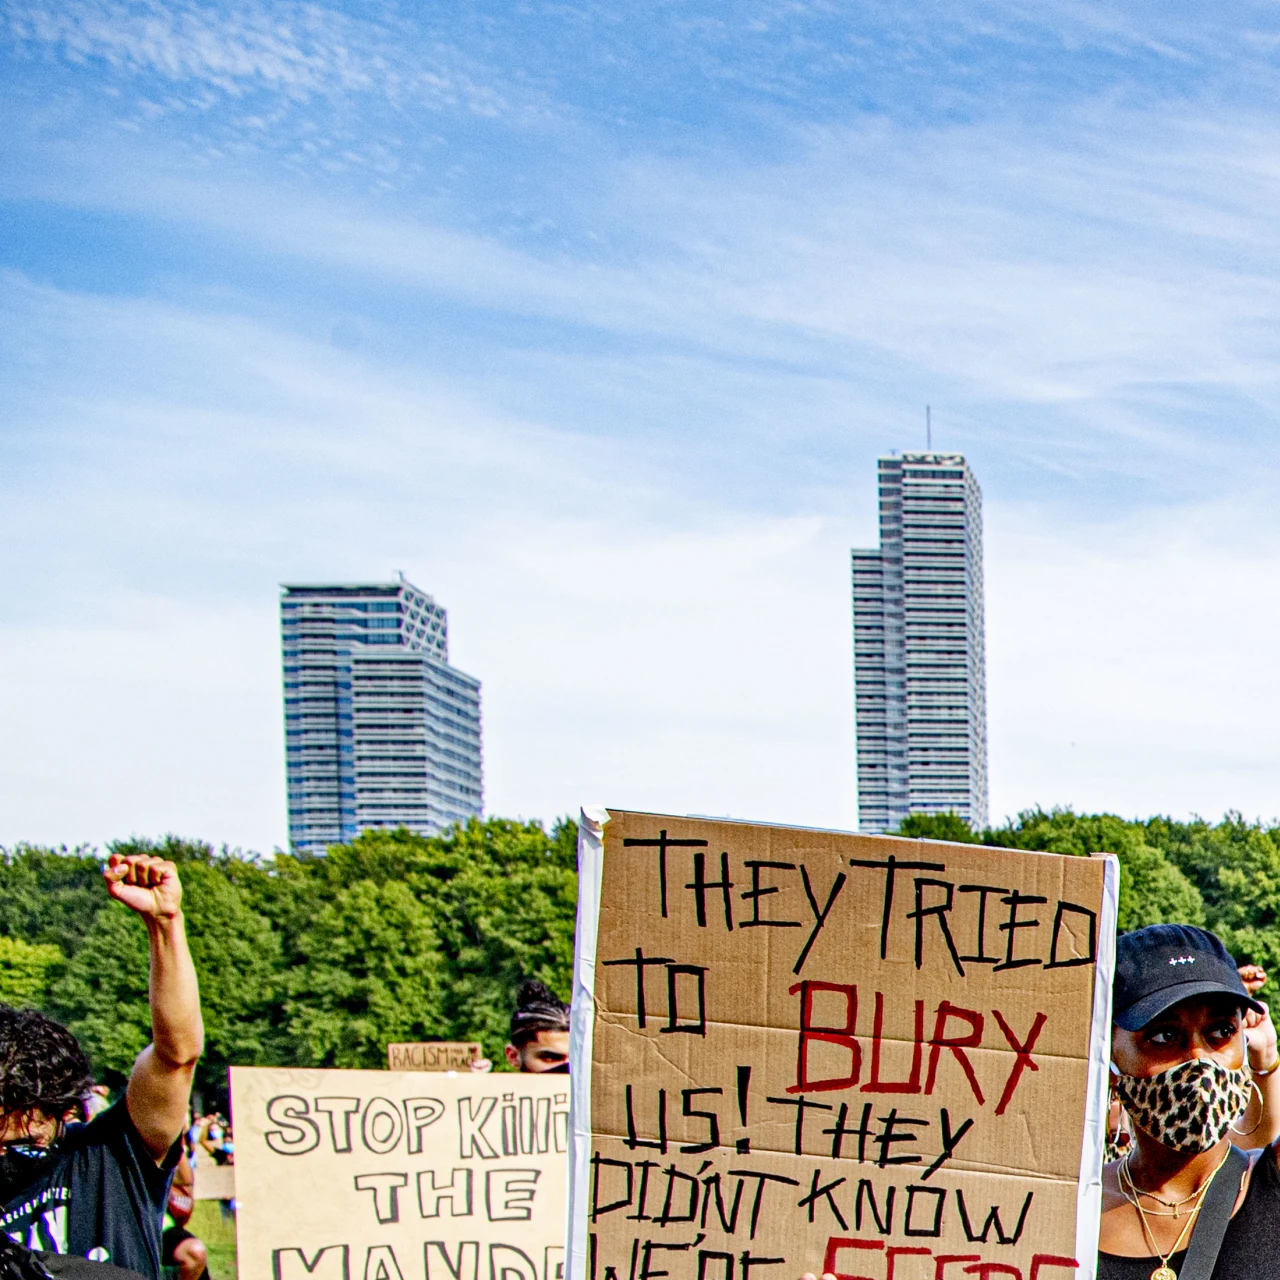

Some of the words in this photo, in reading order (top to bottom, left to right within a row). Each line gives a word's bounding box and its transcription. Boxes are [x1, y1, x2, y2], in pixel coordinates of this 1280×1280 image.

[623, 829, 847, 975] THEY
[849, 854, 1098, 978] TRIED
[602, 947, 709, 1038] TO
[392, 1046, 449, 1067] RACISM
[786, 979, 1047, 1116] BURY
[264, 1094, 446, 1156] STOP
[623, 1065, 752, 1155] US!
[766, 1094, 975, 1181] THEY
[354, 1167, 542, 1224] THE
[798, 1168, 1034, 1246] KNOW
